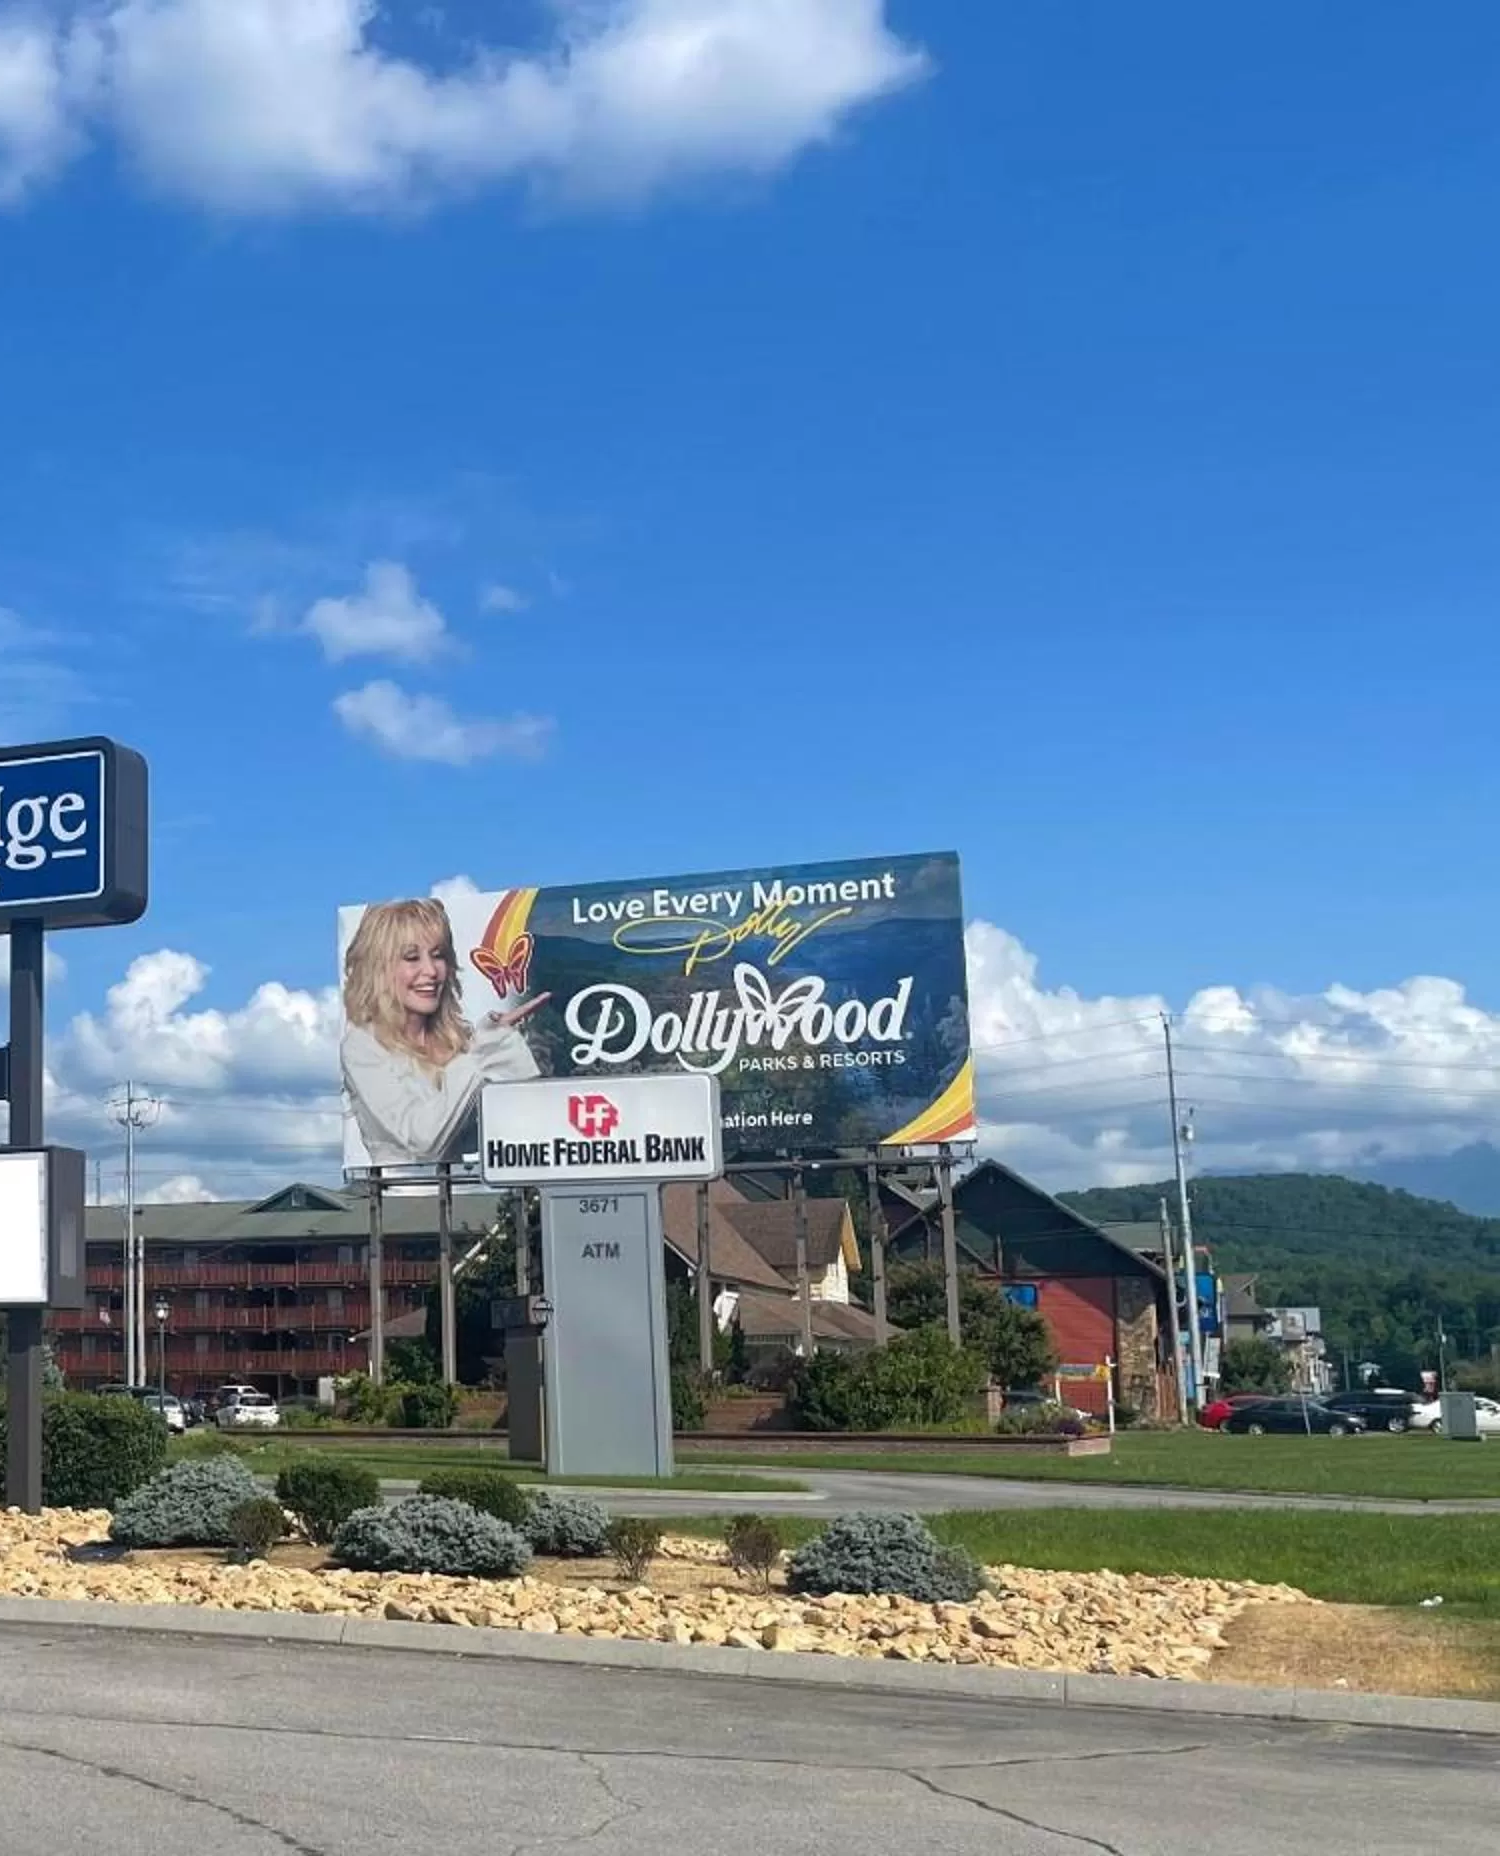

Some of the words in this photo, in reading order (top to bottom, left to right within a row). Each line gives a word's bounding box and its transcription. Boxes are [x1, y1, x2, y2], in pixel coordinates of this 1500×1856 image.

[573, 897, 645, 924] Love
[652, 889, 743, 918] Every
[753, 872, 896, 909] Moment
[613, 896, 852, 976] Dolly
[565, 962, 913, 1075] Dollywood
[739, 1053, 798, 1073] PARKS
[802, 1053, 816, 1070] &
[820, 1050, 907, 1070] RESORTS
[771, 1111, 813, 1126] Here
[488, 1139, 550, 1168] HOME
[554, 1138, 641, 1166] FEDERAL
[645, 1134, 705, 1163] BANK
[582, 1242, 621, 1259] ATM
